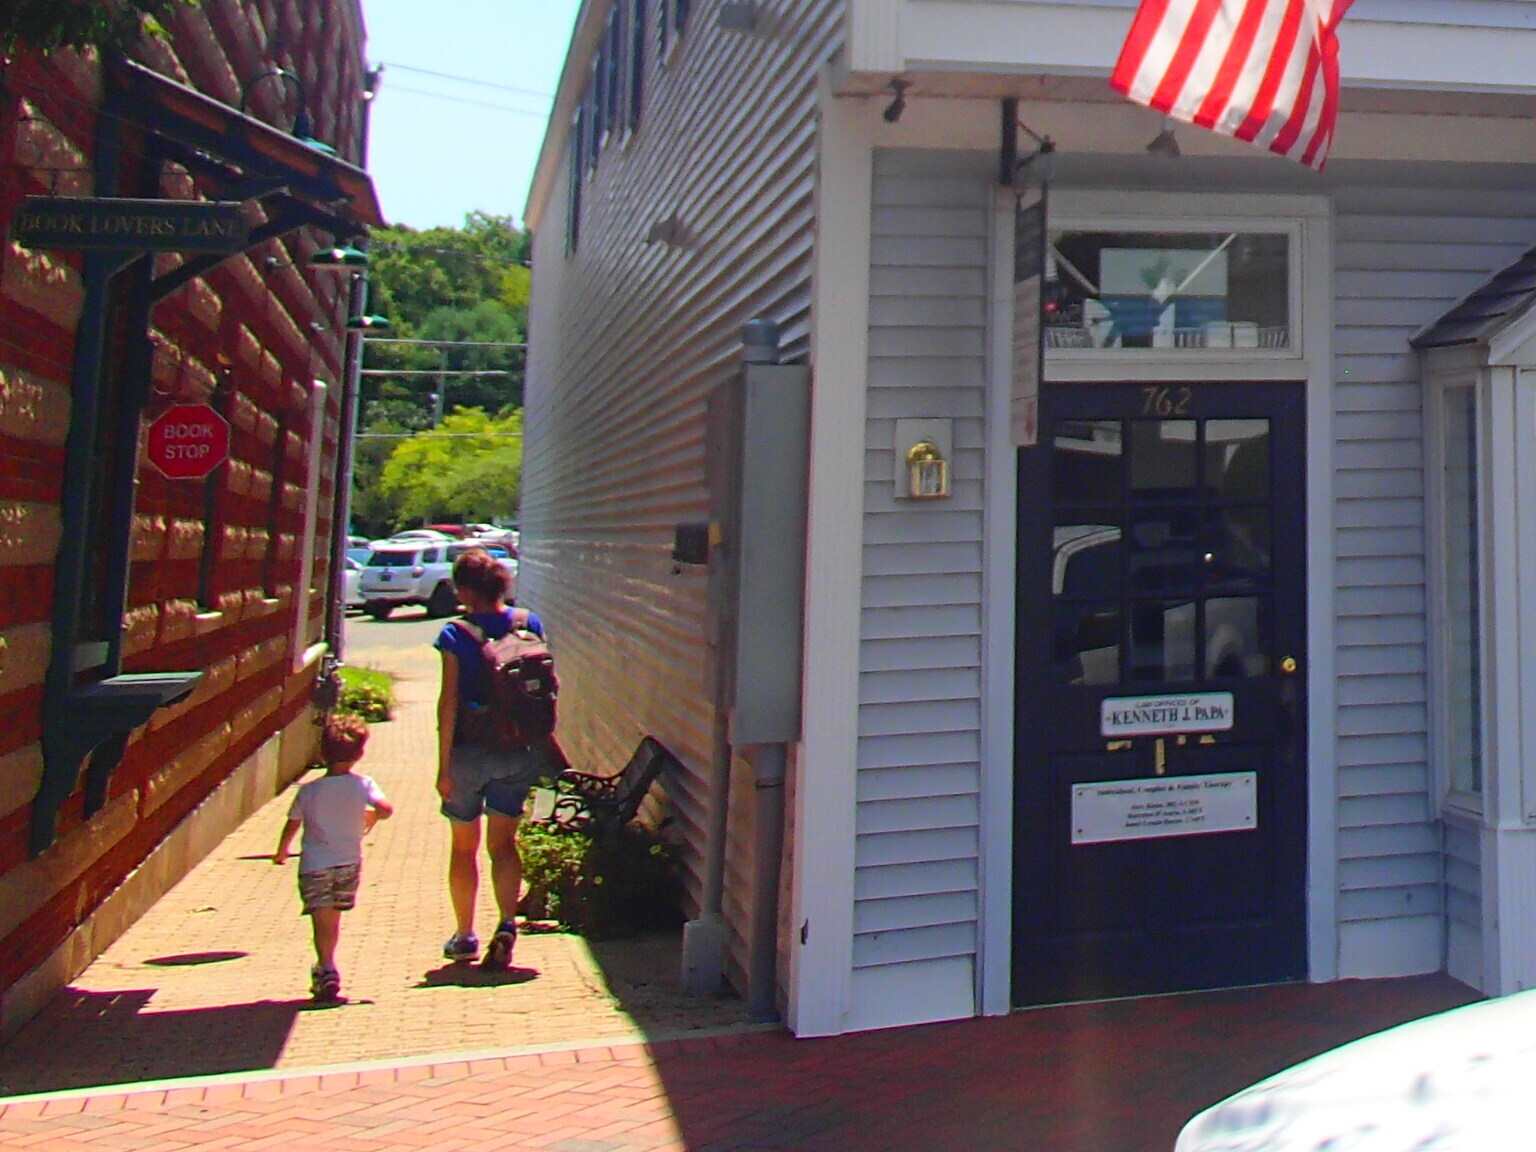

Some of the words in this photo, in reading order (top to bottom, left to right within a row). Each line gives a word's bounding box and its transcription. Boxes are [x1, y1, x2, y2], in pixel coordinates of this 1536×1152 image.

[21, 213, 83, 235] BOOK
[90, 214, 176, 236] LOVERS
[1144, 386, 1192, 416] 762
[163, 424, 214, 439] BOOK
[164, 445, 210, 460] STOP
[1112, 707, 1179, 725] KENNETH
